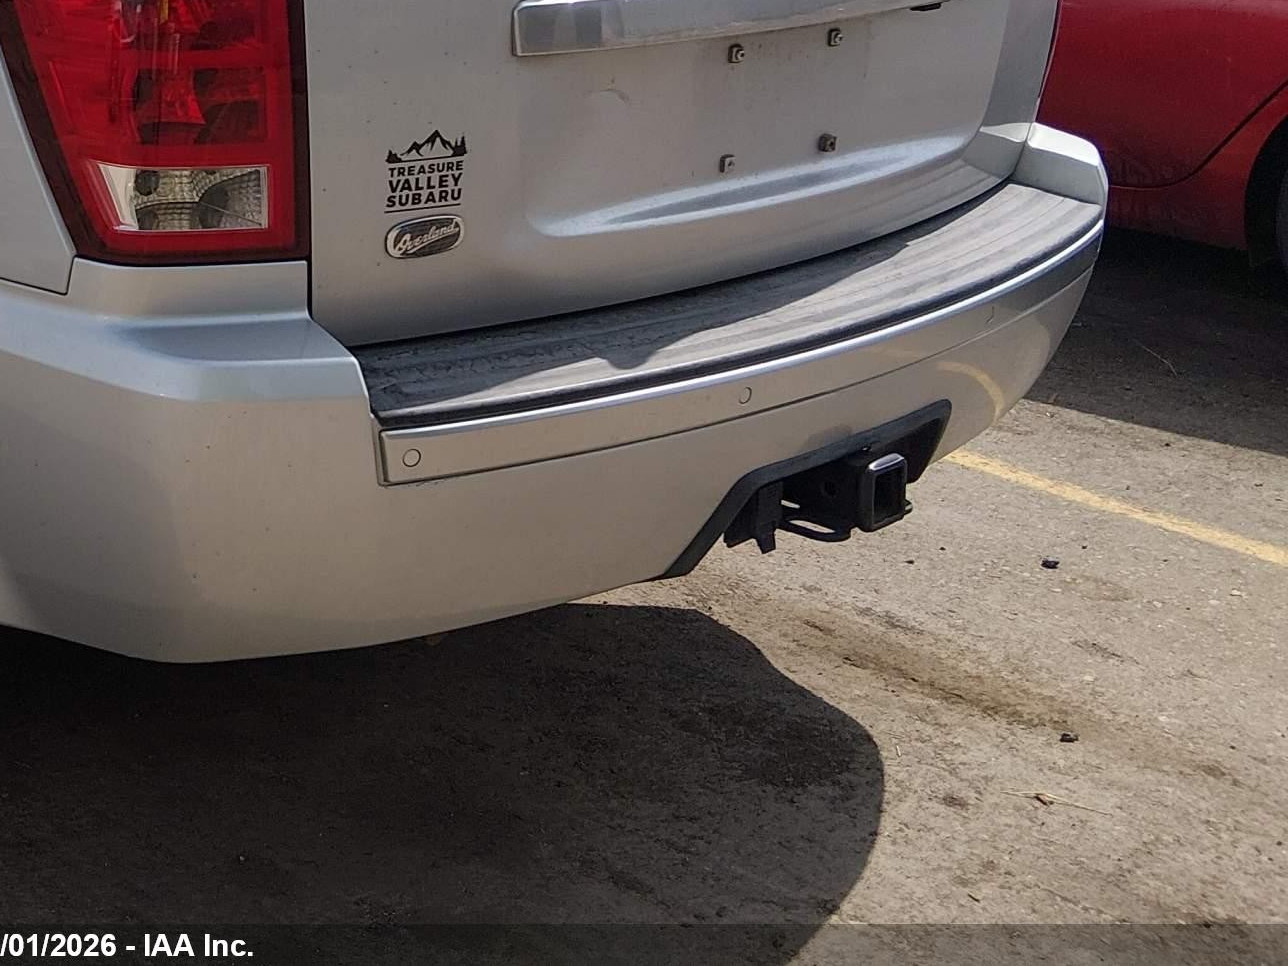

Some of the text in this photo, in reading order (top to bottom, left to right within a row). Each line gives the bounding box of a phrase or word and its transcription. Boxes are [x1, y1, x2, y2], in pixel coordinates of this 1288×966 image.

[388, 160, 464, 179] TREASURE
[388, 172, 463, 194] VALLEY
[385, 187, 462, 208] SUBARU
[394, 219, 459, 253] Overland
